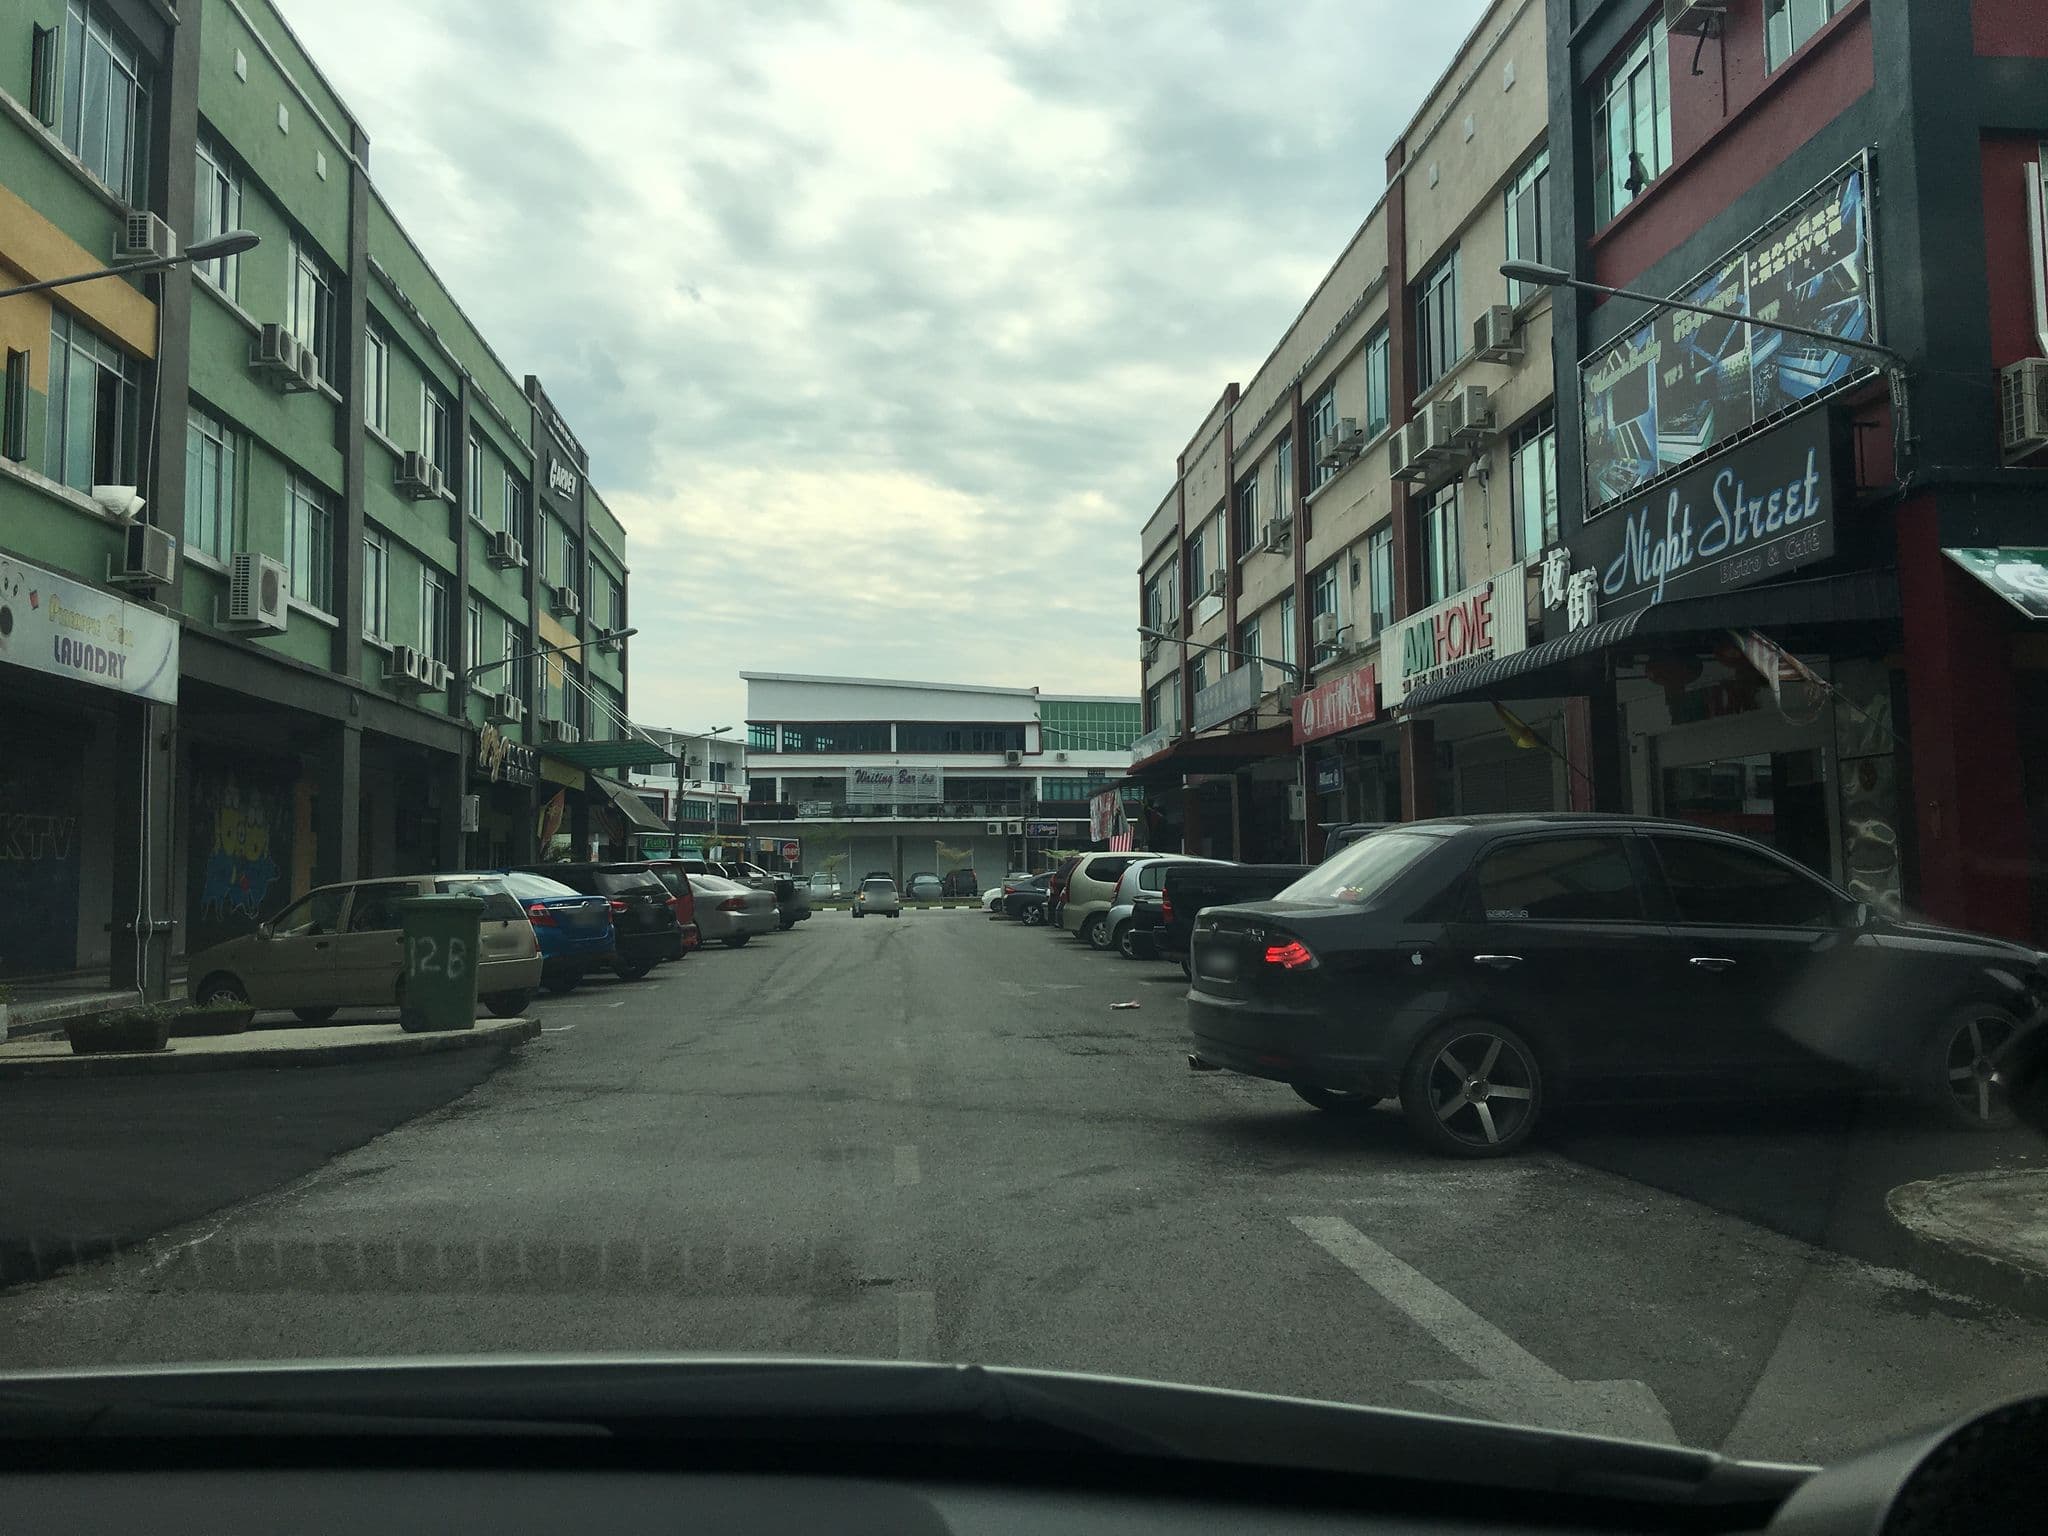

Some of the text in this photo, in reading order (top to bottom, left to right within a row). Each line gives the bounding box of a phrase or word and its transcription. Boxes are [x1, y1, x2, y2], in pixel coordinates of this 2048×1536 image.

[1603, 447, 1820, 606] Night Street
[1720, 555, 1762, 584] Bistro
[1767, 546, 1781, 567] &
[54, 634, 127, 680] LAUNDRY
[899, 769, 916, 784] Bar
